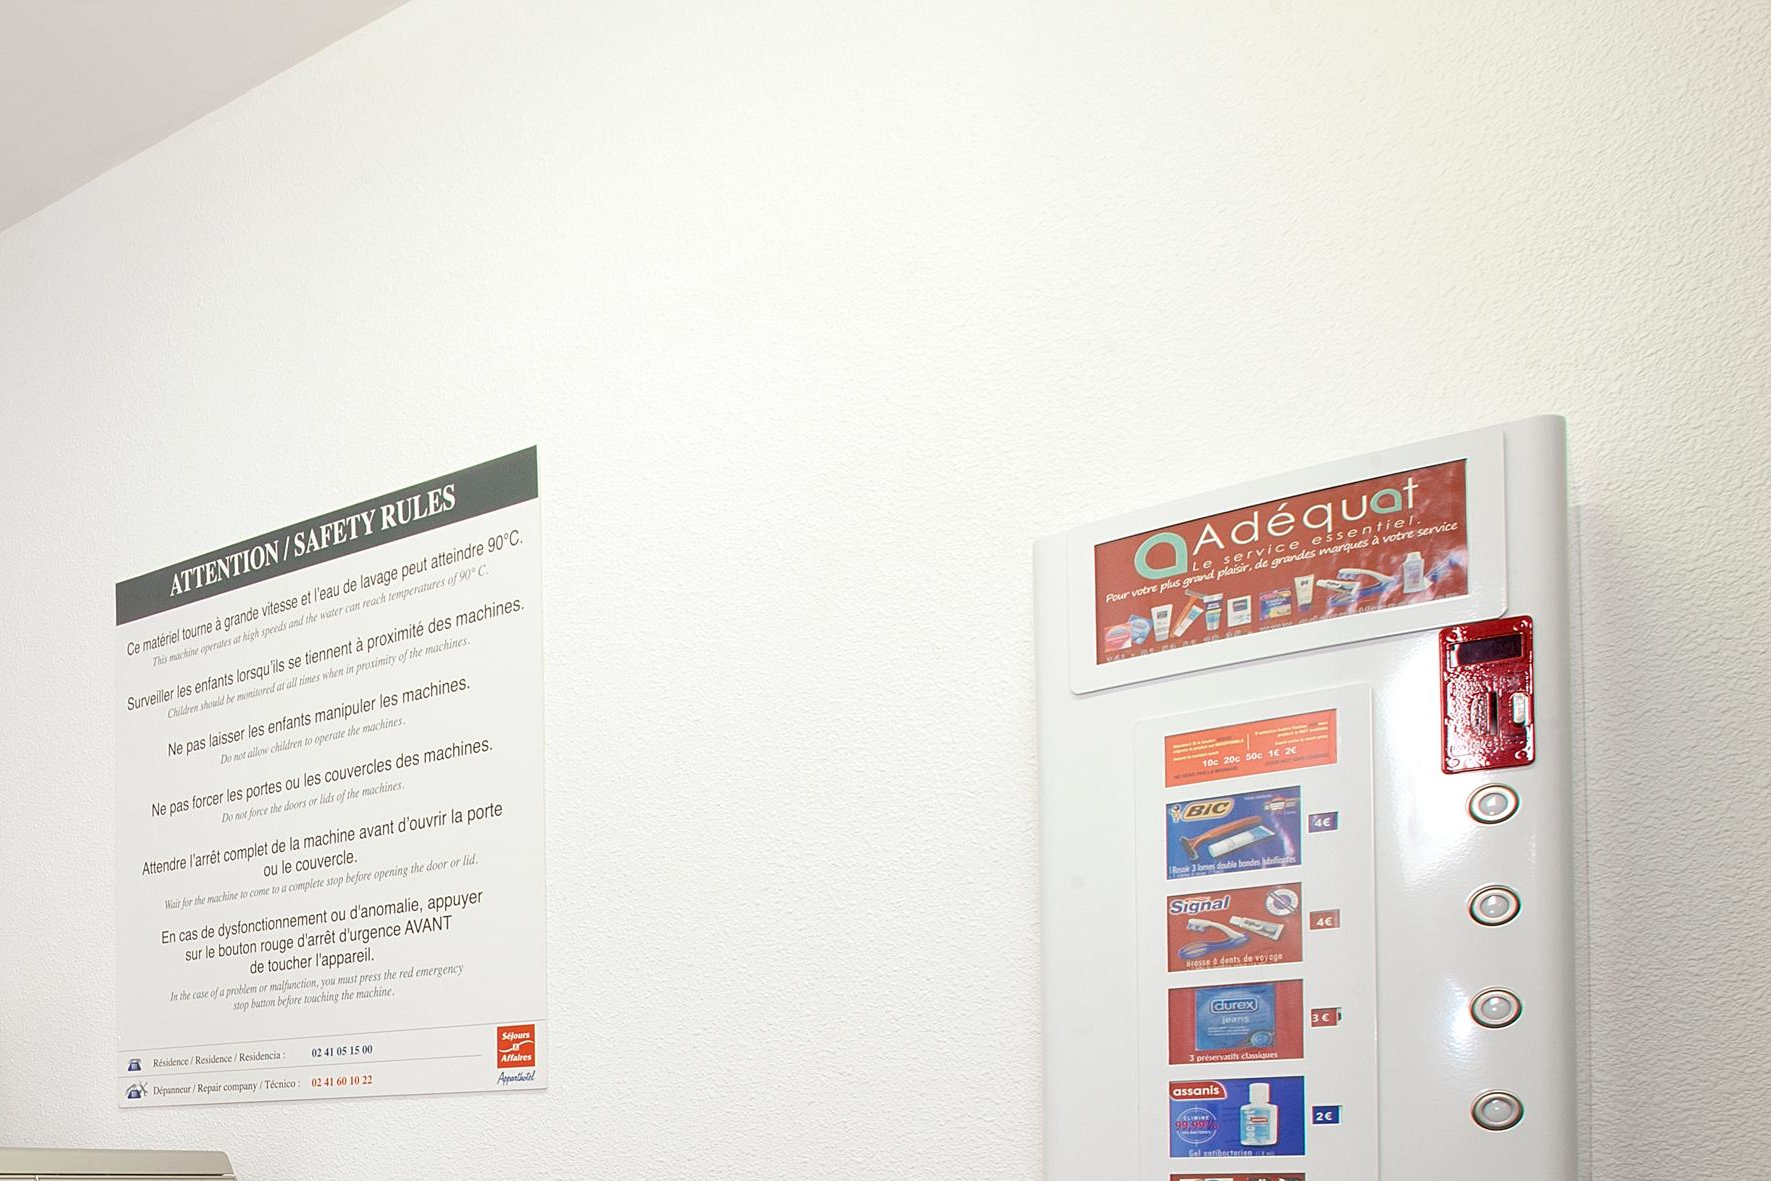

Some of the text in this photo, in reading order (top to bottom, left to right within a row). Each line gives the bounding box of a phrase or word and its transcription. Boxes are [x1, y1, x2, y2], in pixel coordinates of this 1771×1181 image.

[1192, 477, 1419, 555] Adéquat
[169, 539, 279, 597] ATTENTION
[294, 508, 376, 557] SAFETY
[379, 483, 456, 530] RULES
[1192, 515, 1420, 571] Le service essentiel.
[1105, 521, 1457, 603] Pour votre plus grand plaisir, de grandes marques à votre service
[126, 529, 523, 656] Ce matériel tourne à grande vitesse et l'eau de lavage peut atteindre 90°C.
[127, 599, 524, 711] Surveiller les enfants lorsqu'ils se tiennent à proximité des machines.
[168, 678, 470, 757] Ne pas laisser les enfants manipuler les machines.
[1202, 759, 1218, 767] 10c
[1223, 755, 1240, 764] 20c
[1245, 752, 1263, 761] 50c
[1268, 748, 1280, 757] 1€
[1284, 745, 1297, 755] 2€
[1185, 801, 1230, 817] BIC
[1314, 817, 1330, 827] 4€
[1169, 896, 1230, 916] Signal
[161, 891, 483, 944] En cas de dysfonctionnement ou d'anomalie, appuyer
[1316, 916, 1332, 926] 4€
[185, 914, 452, 961] sur le bouton rouge d'arrêt d'urgence AVANT
[249, 946, 374, 974] de toucher l'appareil.
[1213, 997, 1254, 1012] durex
[502, 1032, 530, 1041] Séjours
[311, 1044, 373, 1057] 02 41 05 15 00
[501, 1053, 532, 1062] Affaires
[1189, 1051, 1278, 1062] 3 préservatifs classiques
[311, 1074, 372, 1087] 02 41 60 10 22
[1172, 1085, 1219, 1096] assanis
[1316, 1111, 1332, 1121] 2€
